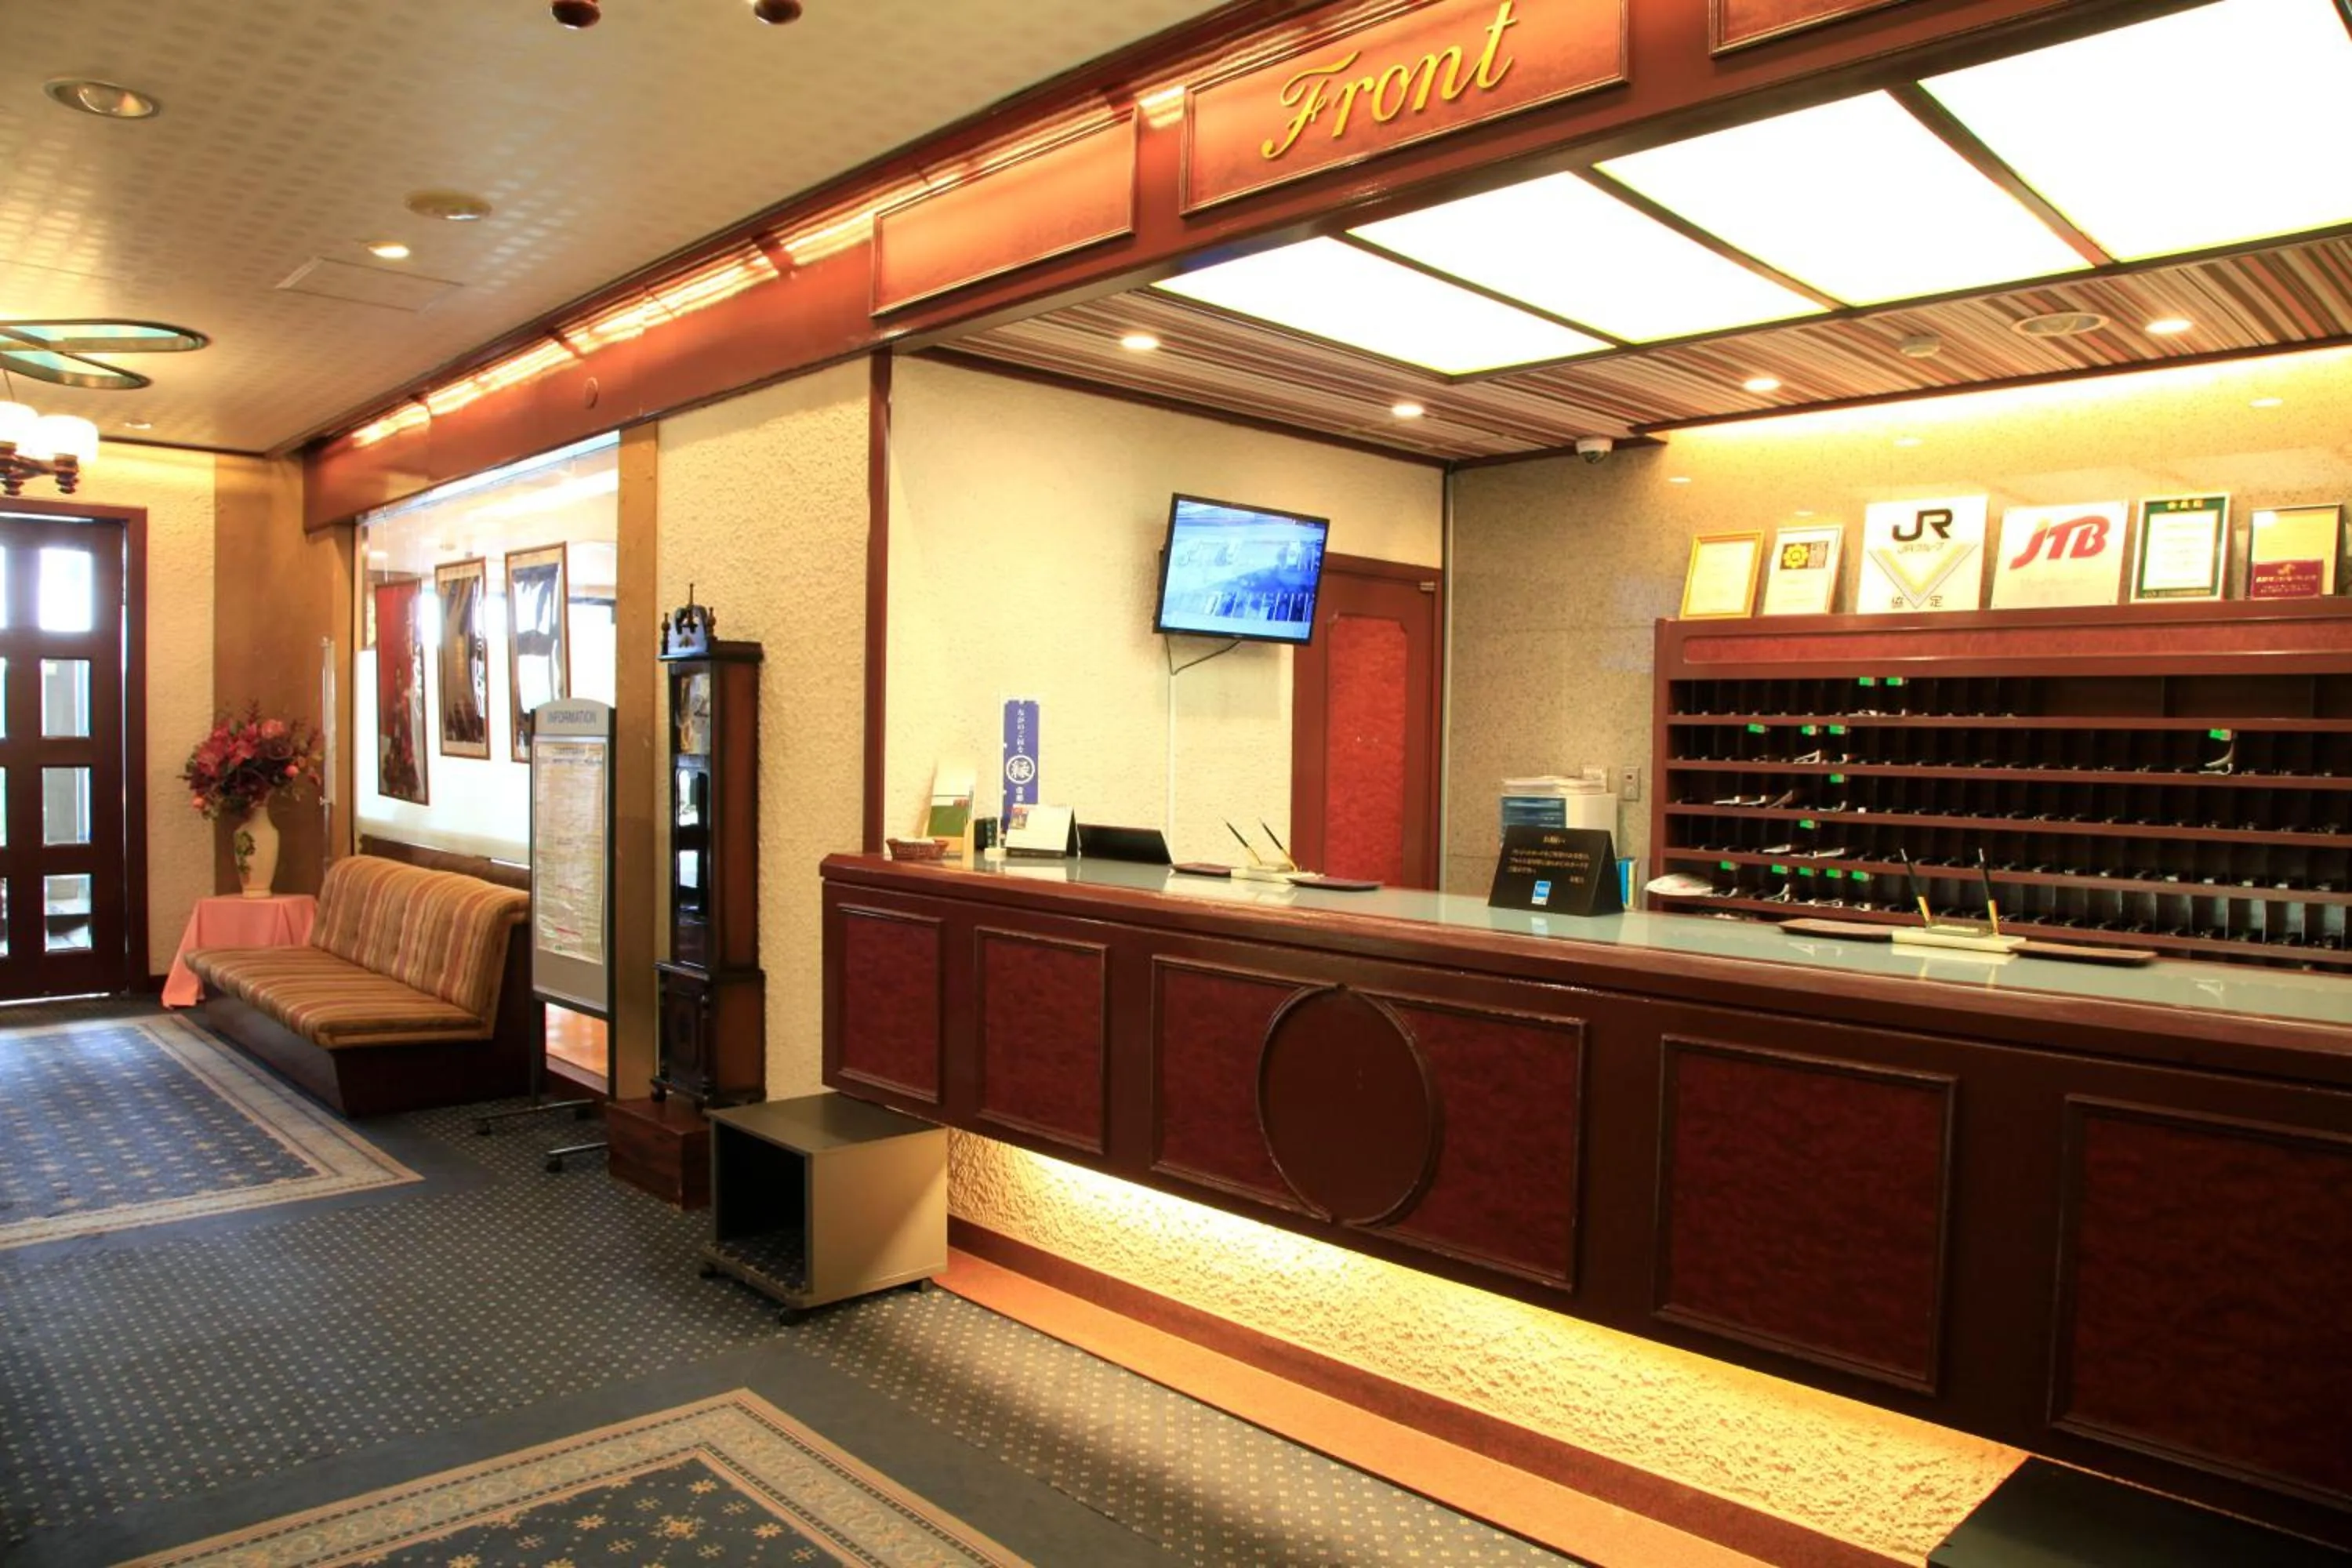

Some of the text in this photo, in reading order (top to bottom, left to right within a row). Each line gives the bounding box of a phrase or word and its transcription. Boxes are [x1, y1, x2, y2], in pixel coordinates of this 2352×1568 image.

[1261, 0, 1517, 158] Front
[1892, 508, 1953, 542] JR
[2009, 515, 2110, 570] JTB
